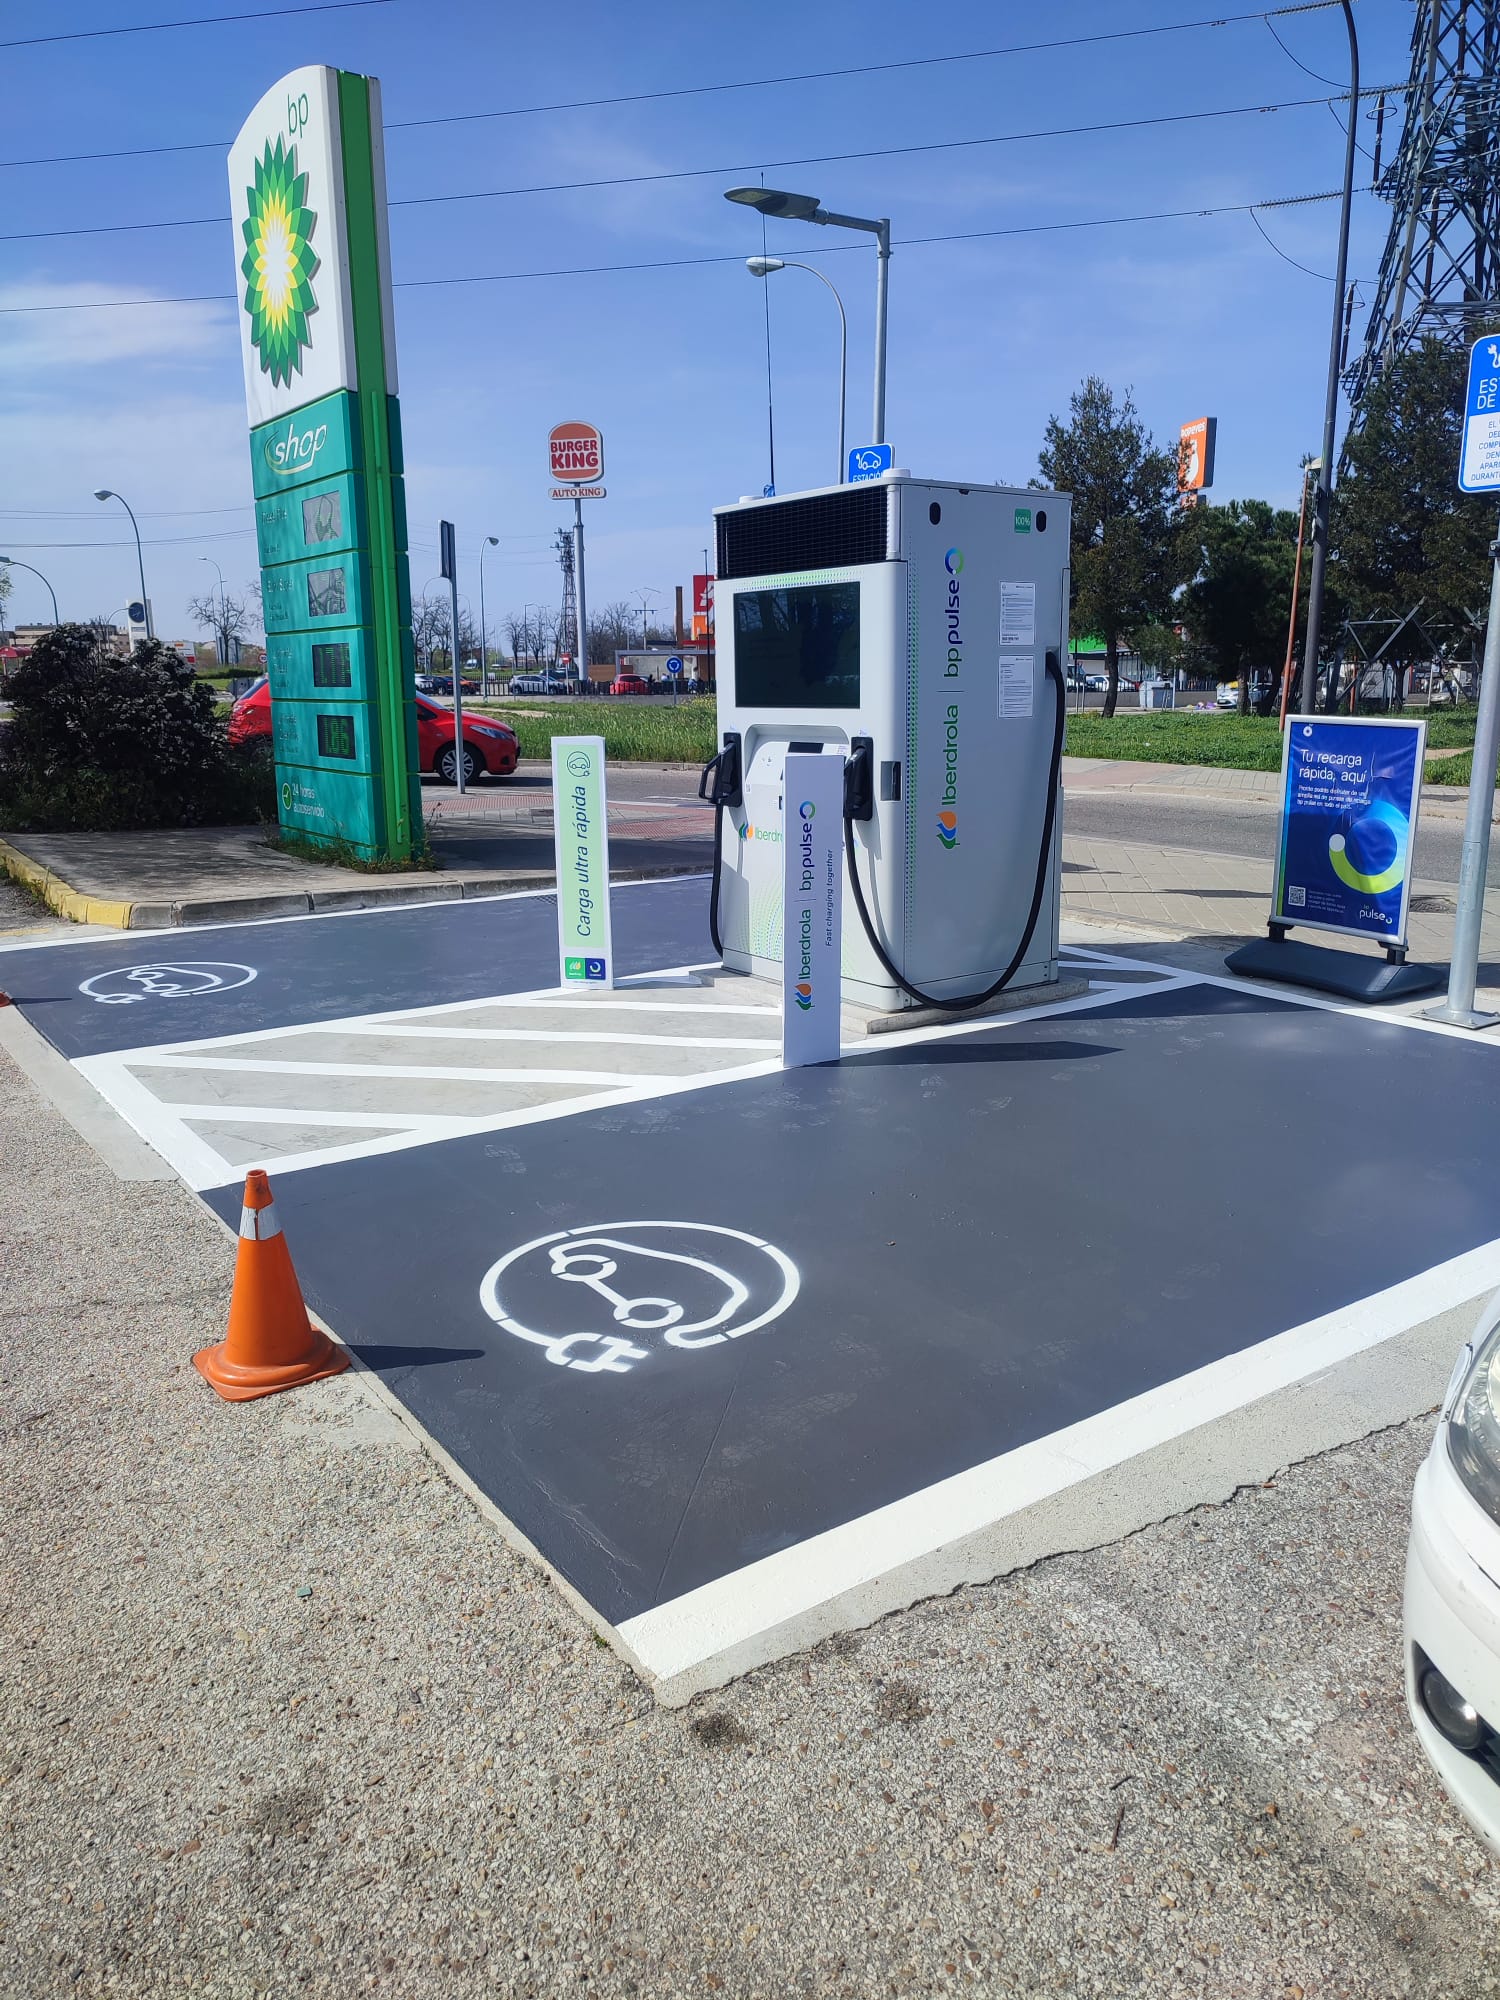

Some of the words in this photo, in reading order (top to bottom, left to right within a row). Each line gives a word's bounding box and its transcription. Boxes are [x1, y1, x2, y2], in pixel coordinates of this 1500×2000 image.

[287, 93, 309, 139] bp
[1479, 377, 1500, 394] ES
[1477, 393, 1497, 410] DE
[1488, 420, 1497, 429] EL
[275, 423, 328, 466] shop
[550, 440, 598, 453] BURGER
[1478, 440, 1500, 450] COMP
[551, 452, 599, 469] KING
[1480, 461, 1500, 471] APAR
[852, 471, 883, 483] ESTACIÓ
[1470, 471, 1500, 481] DURANT
[552, 489, 577, 498] AUTO
[578, 488, 601, 497] KING
[1015, 516, 1031, 526] 100%
[941, 704, 959, 806] Iberdrola
[1300, 749, 1314, 763] Tu
[1316, 752, 1362, 769] recarga
[1299, 766, 1336, 783] rápida,
[1341, 769, 1368, 785] aquí
[571, 786, 591, 839] rápida
[574, 845, 589, 883] ultra
[826, 849, 835, 887] together
[577, 888, 594, 937] Carga
[826, 887, 835, 927] charging
[1359, 909, 1386, 921] pulse
[798, 908, 812, 980] Iberdrola
[825, 931, 833, 947] Fast
